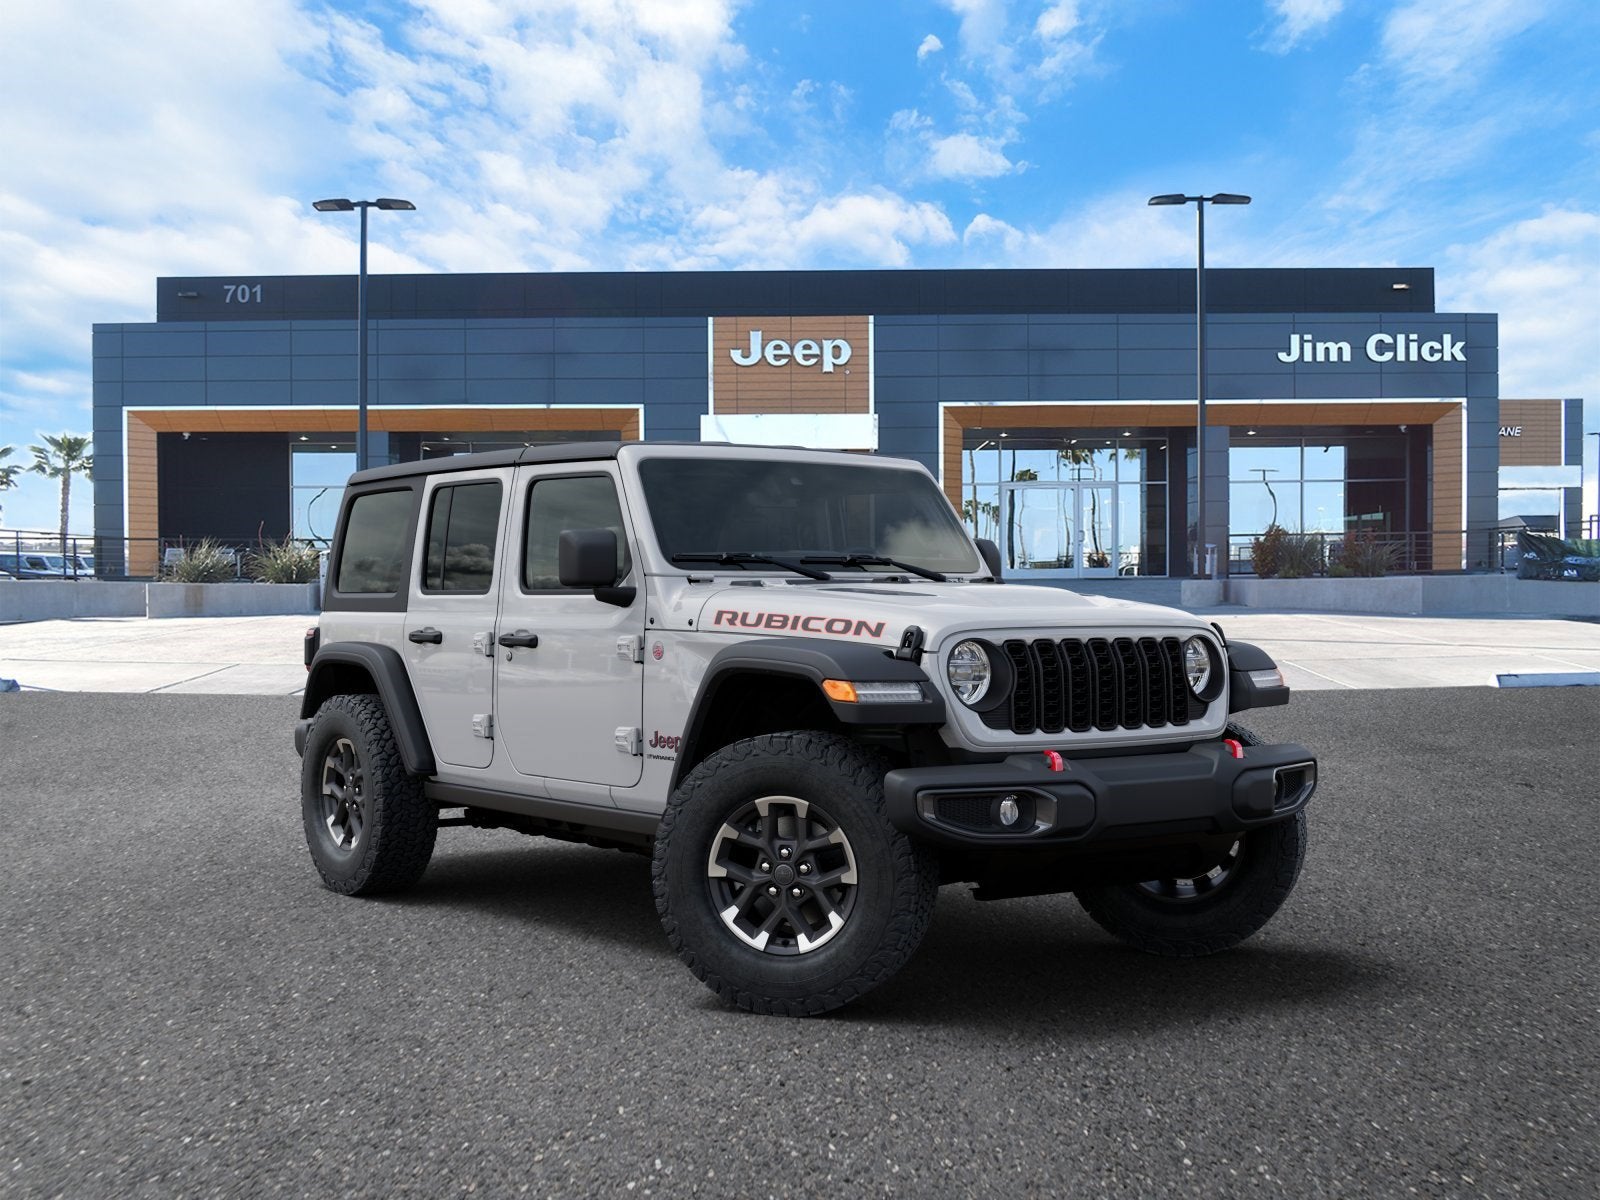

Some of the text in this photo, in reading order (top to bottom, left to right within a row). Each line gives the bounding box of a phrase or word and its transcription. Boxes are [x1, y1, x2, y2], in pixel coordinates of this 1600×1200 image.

[223, 284, 263, 304] 701
[730, 330, 852, 374] Jeep
[1277, 333, 1467, 363] Jim Click
[713, 609, 887, 638] RUBICON
[649, 730, 681, 753] Jeep
